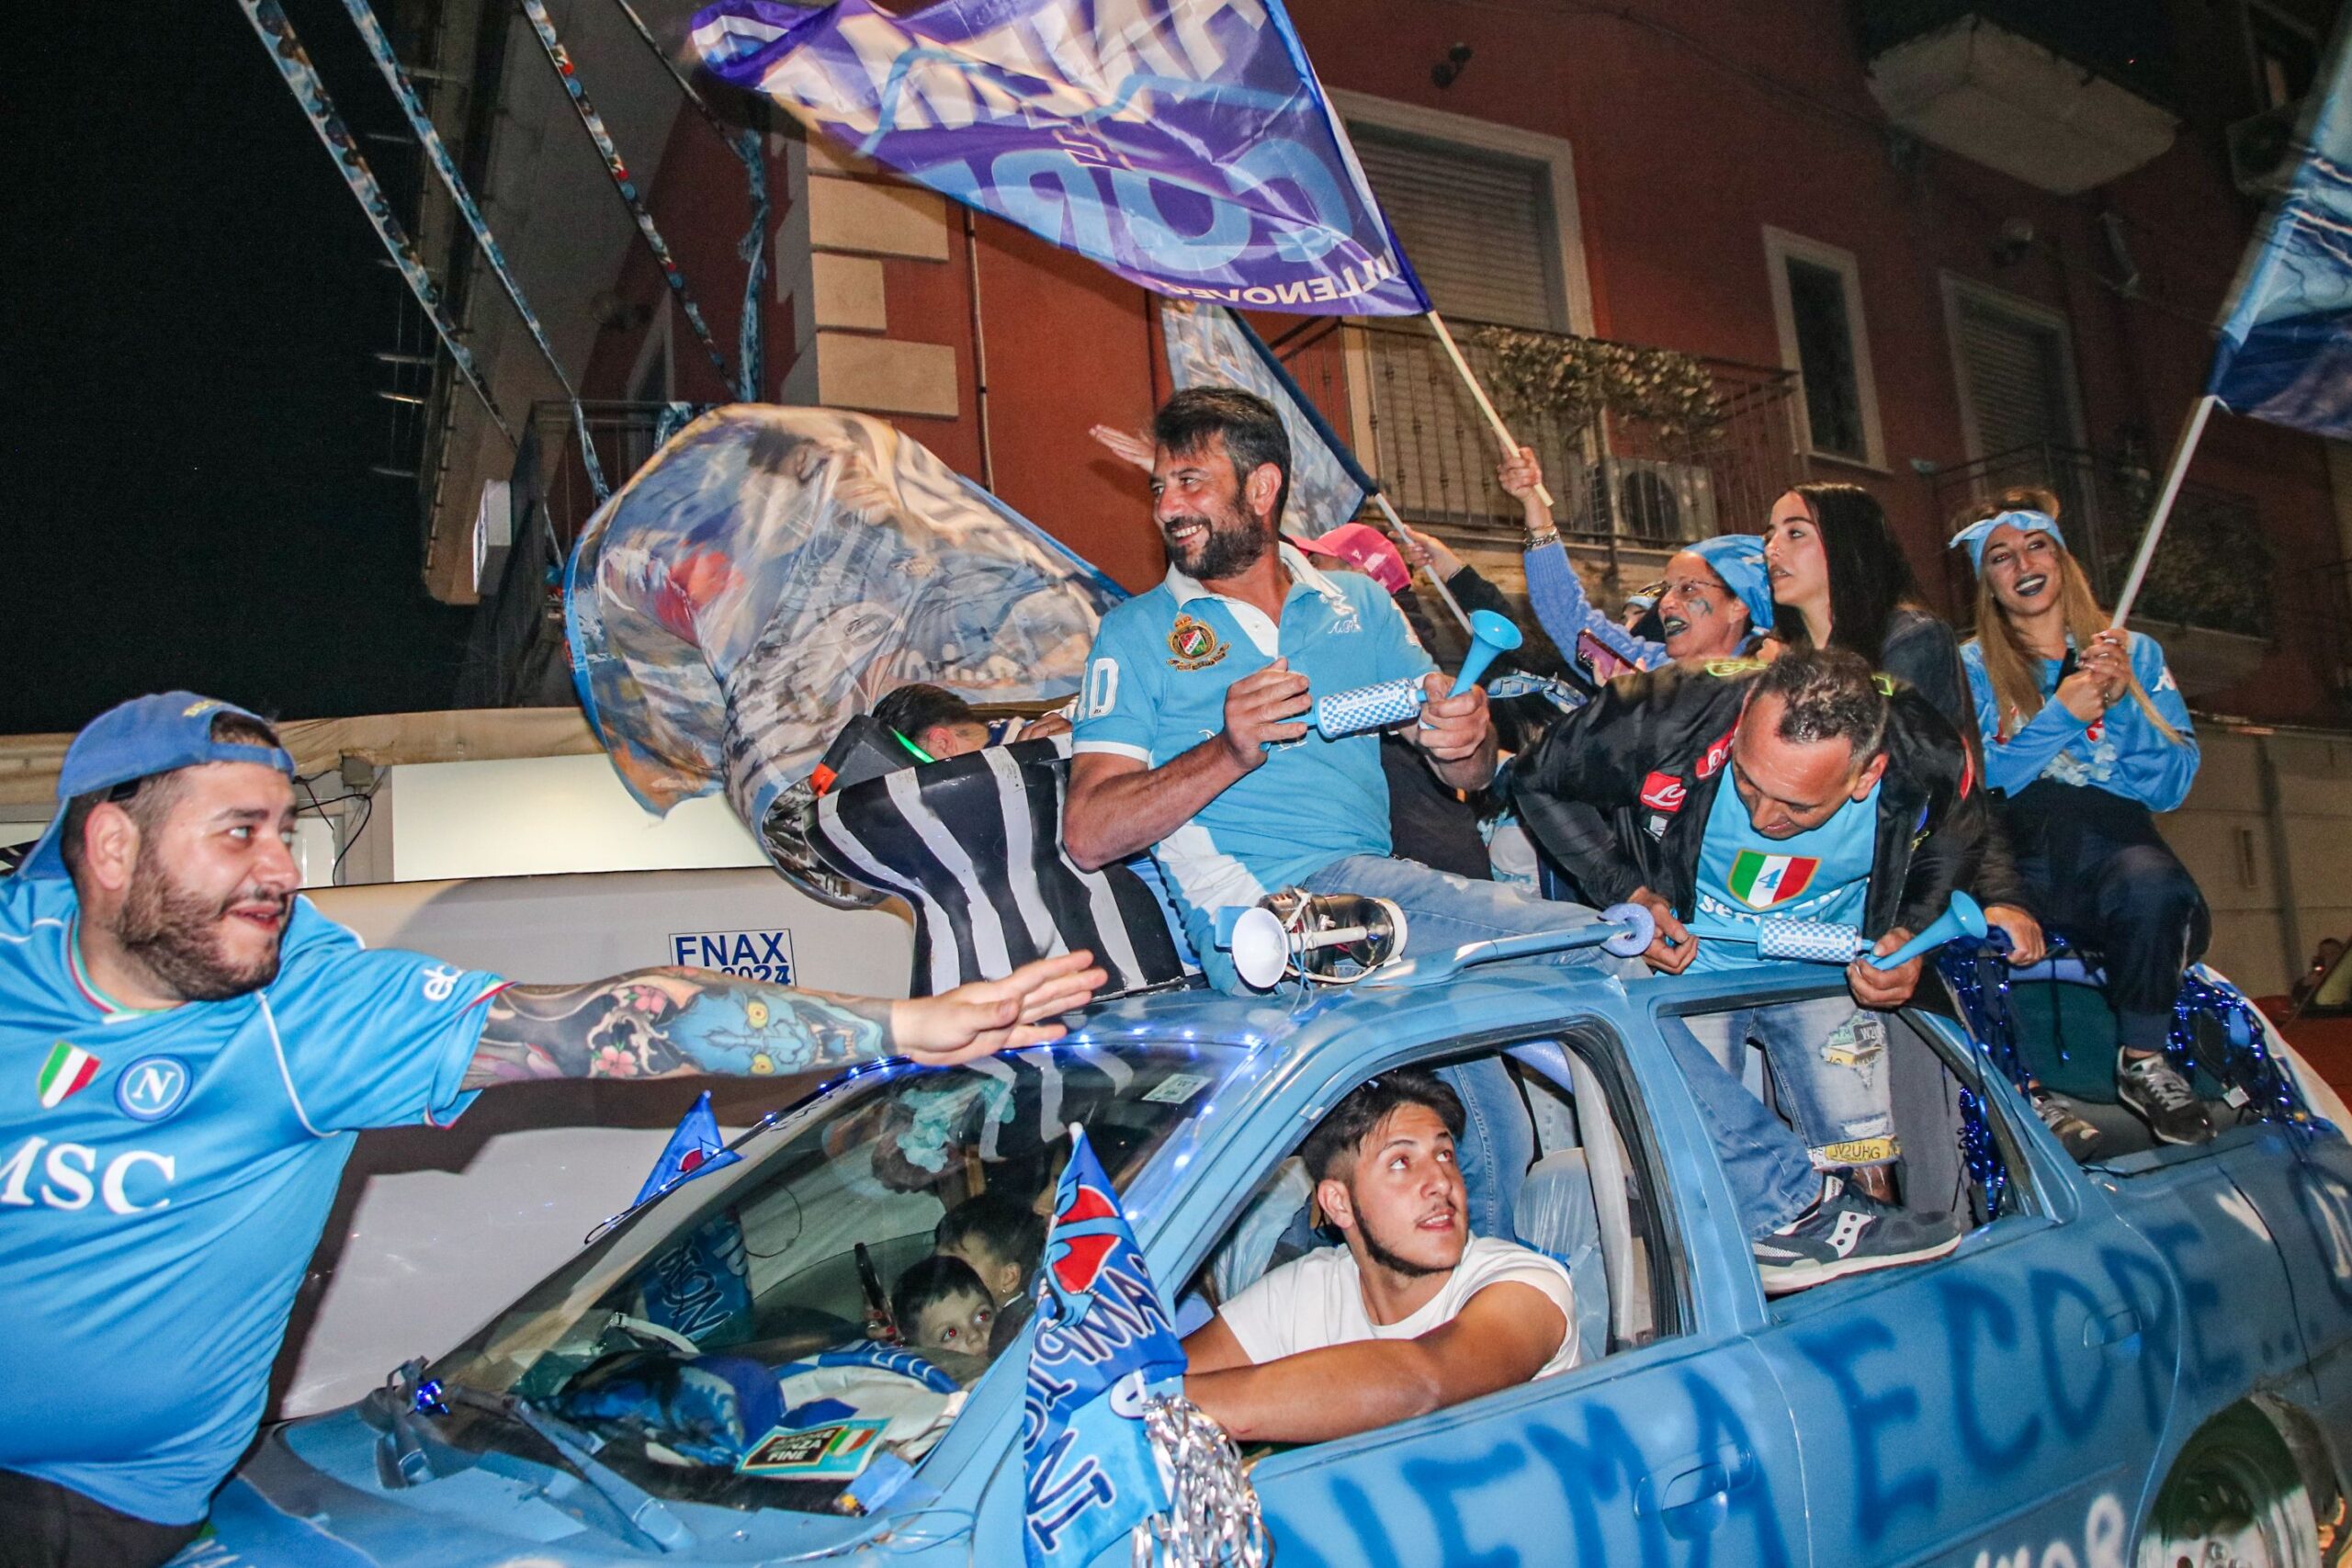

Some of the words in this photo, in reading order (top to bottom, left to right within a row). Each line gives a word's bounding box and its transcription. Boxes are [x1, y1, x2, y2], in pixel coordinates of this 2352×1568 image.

[1757, 868, 1782, 890] 4
[675, 931, 787, 967] FNAX
[131, 1067, 176, 1104] N
[766, 1450, 808, 1462] FINE
